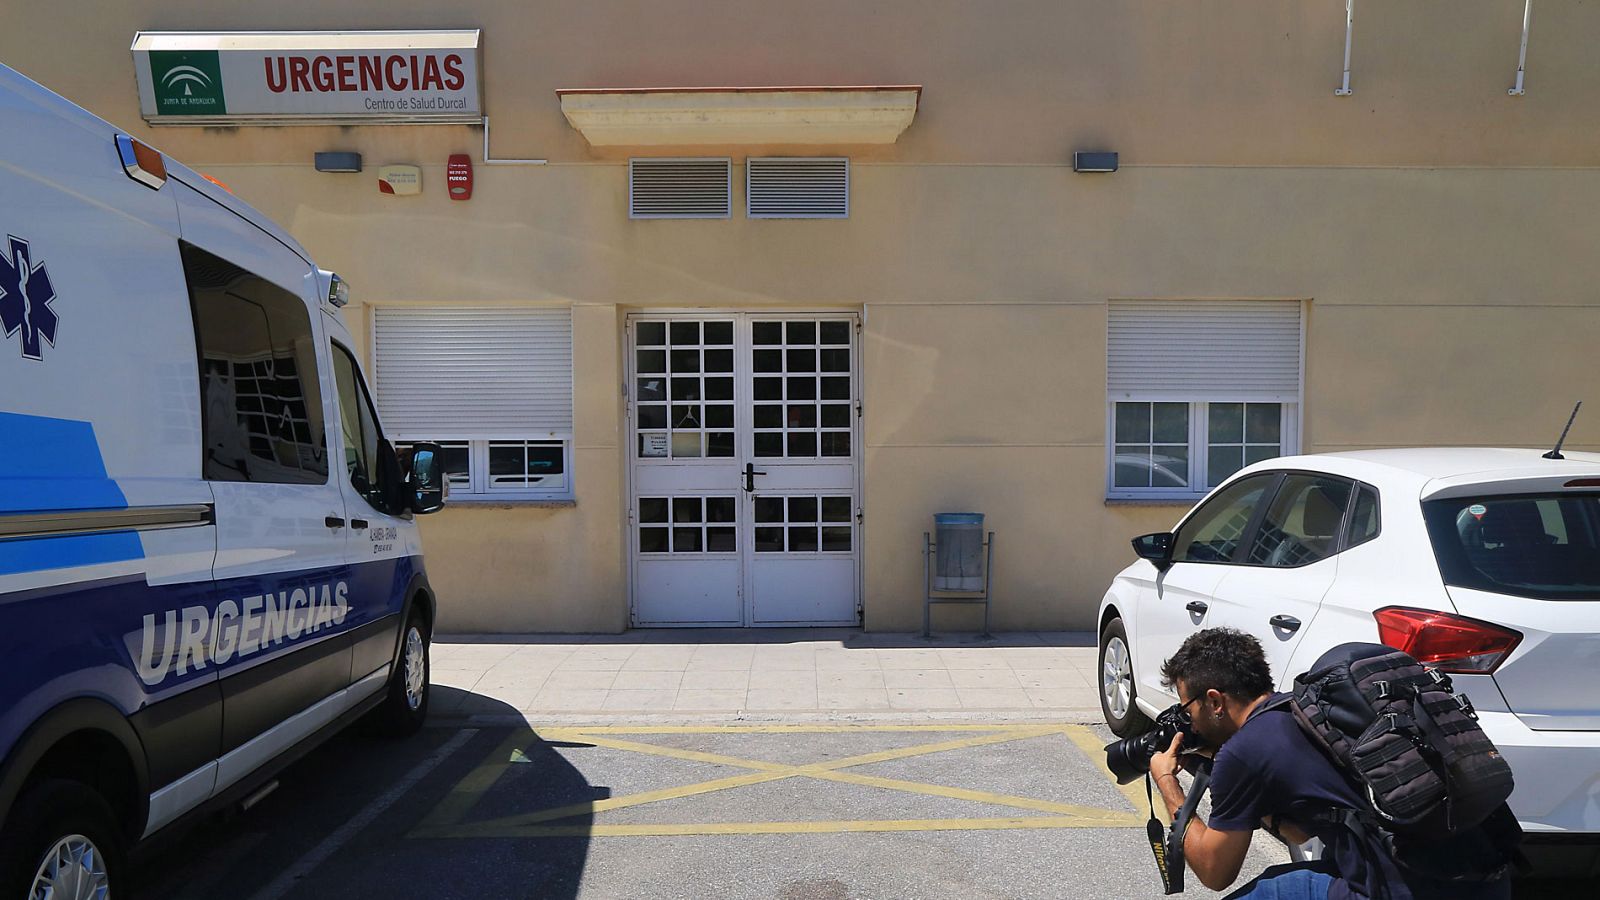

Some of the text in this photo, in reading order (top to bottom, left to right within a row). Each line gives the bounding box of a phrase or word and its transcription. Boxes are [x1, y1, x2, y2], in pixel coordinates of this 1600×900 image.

[264, 54, 465, 93] URGENCIAS
[365, 97, 467, 110] Centro de Salud Durcal
[139, 581, 348, 686] URGENCIAS
[1153, 842, 1166, 871] Nikon
